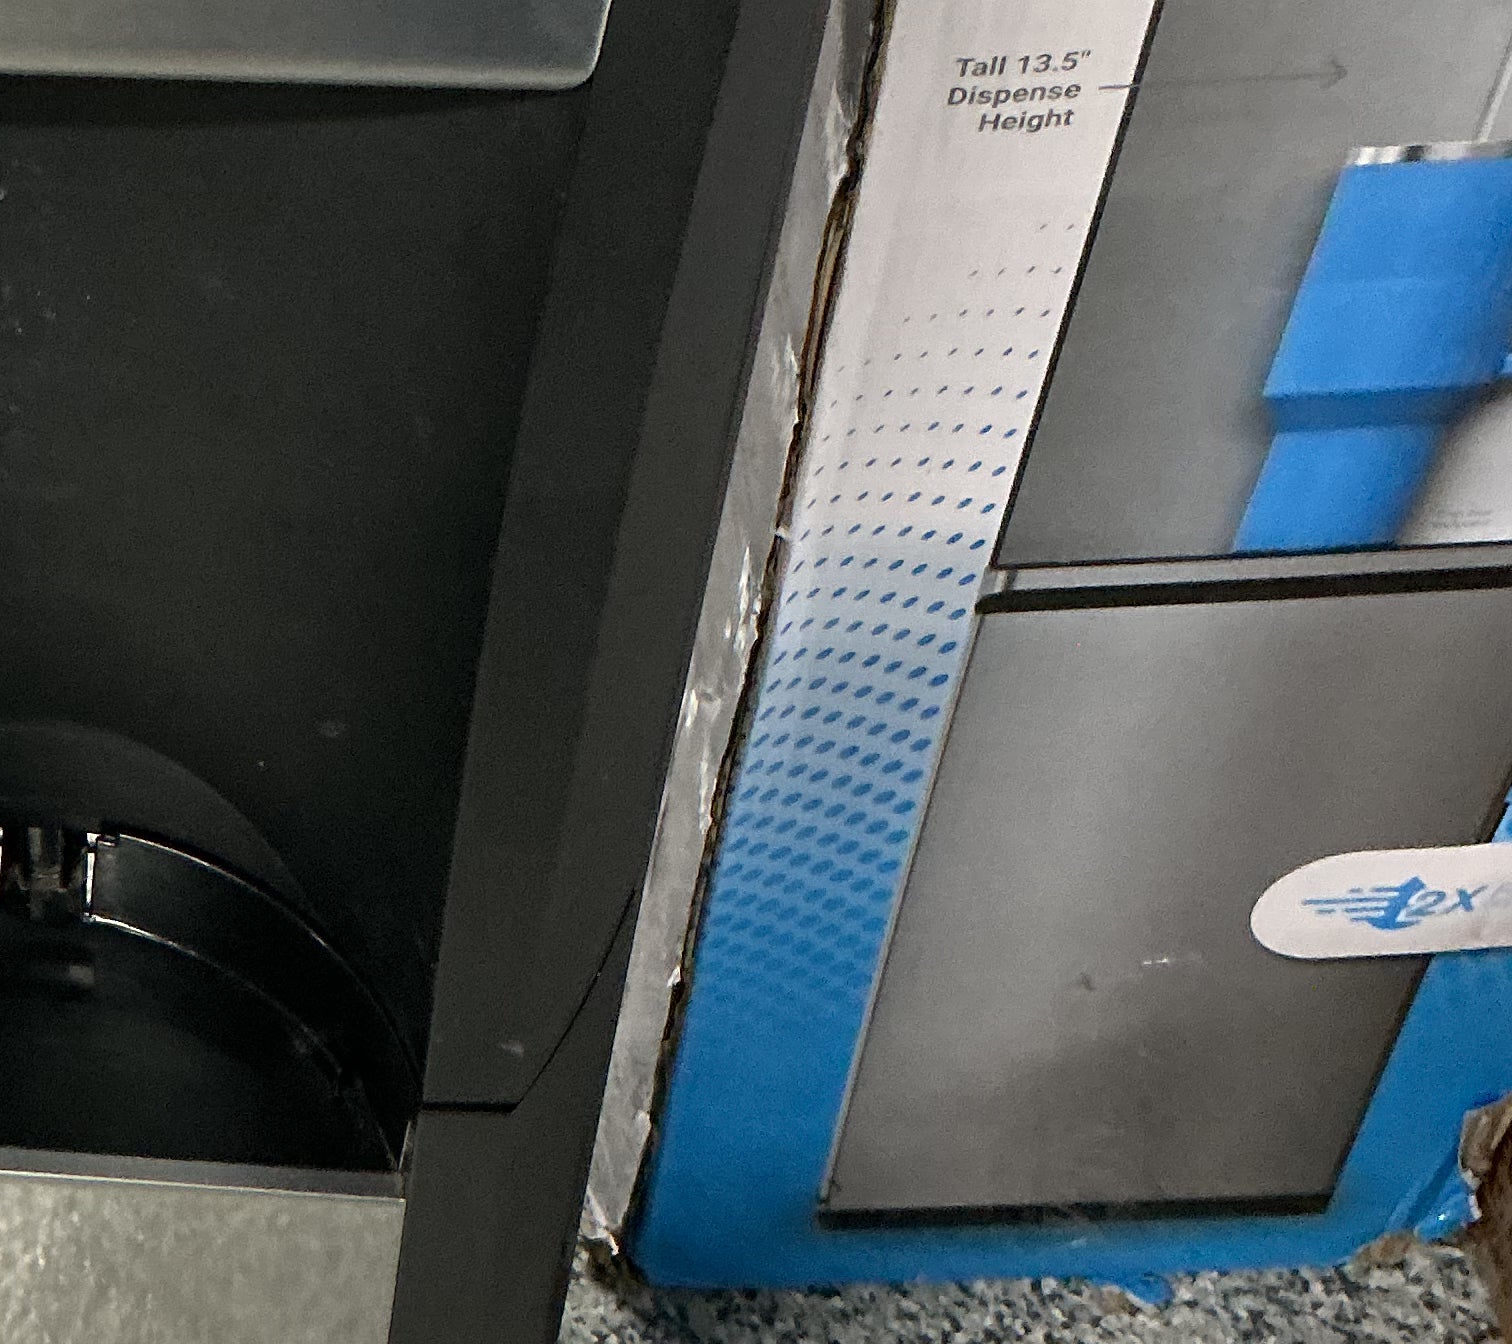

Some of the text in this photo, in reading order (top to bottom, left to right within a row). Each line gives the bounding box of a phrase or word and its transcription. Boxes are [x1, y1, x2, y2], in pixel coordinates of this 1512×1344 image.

[956, 55, 1007, 78] Tall
[947, 83, 1082, 108] Dispense
[977, 108, 1075, 133] Height
